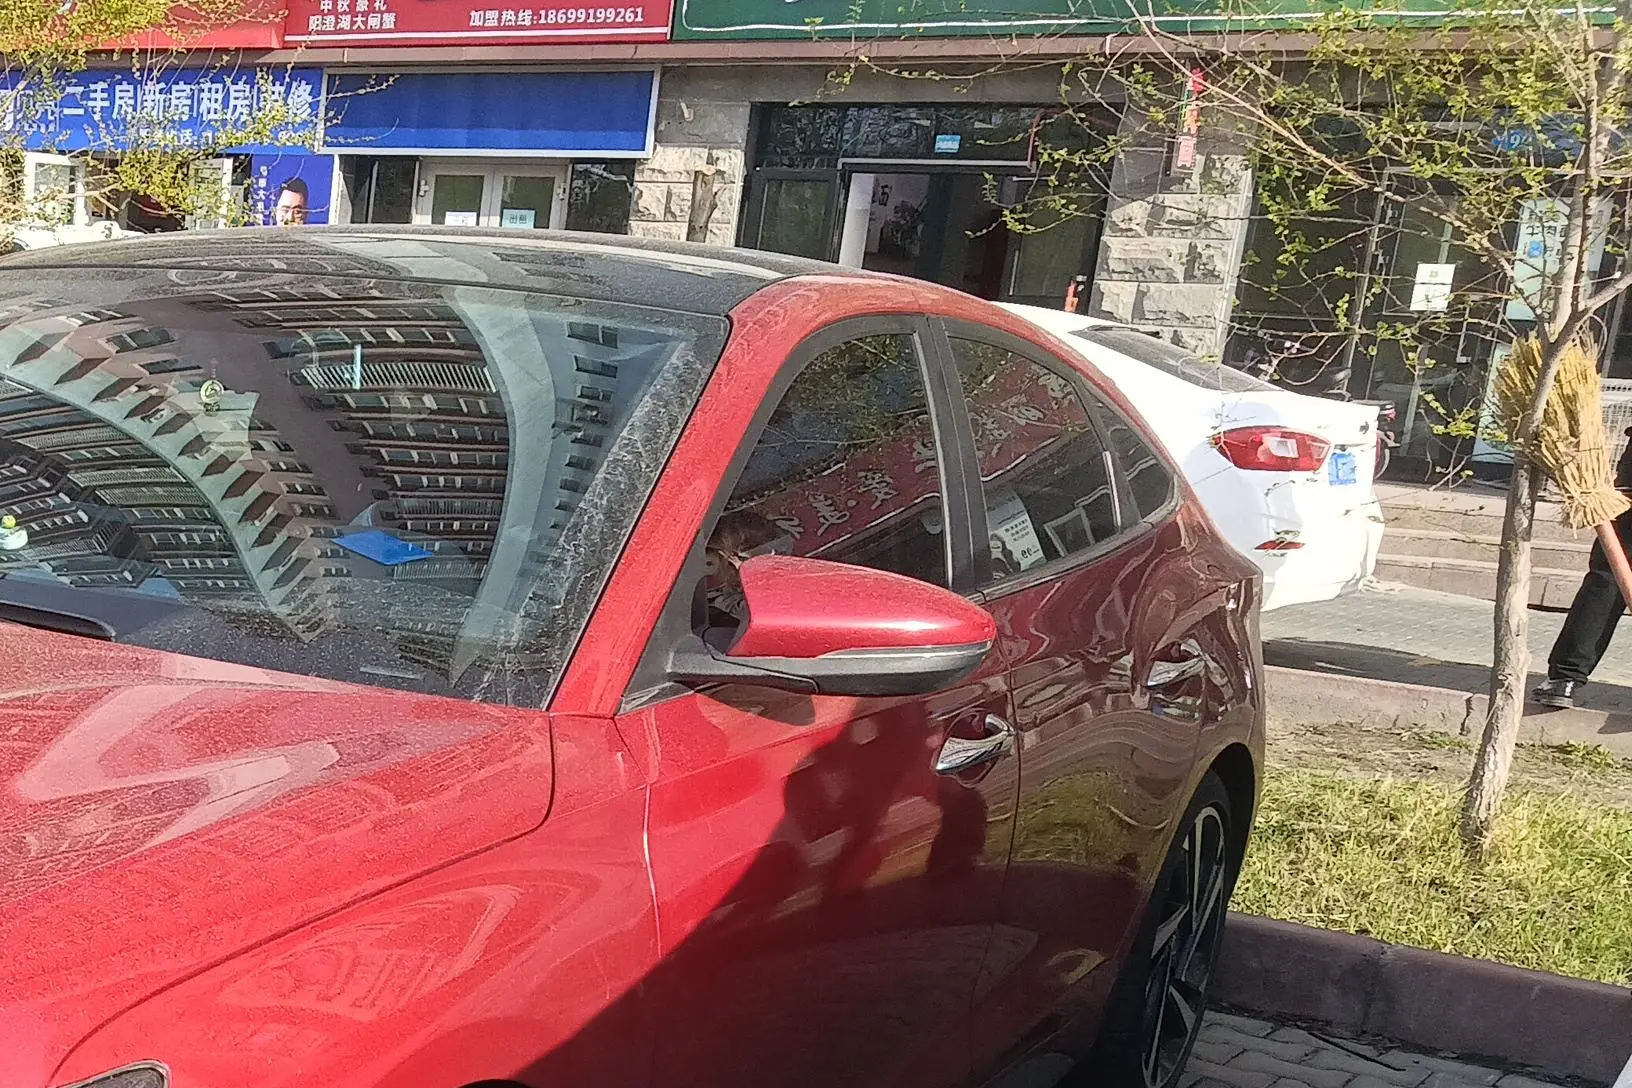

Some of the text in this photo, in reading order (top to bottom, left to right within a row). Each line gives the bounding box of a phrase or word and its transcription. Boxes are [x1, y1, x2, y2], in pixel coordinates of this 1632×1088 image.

[308, 12, 396, 31] 阳澄湖大闸蟹
